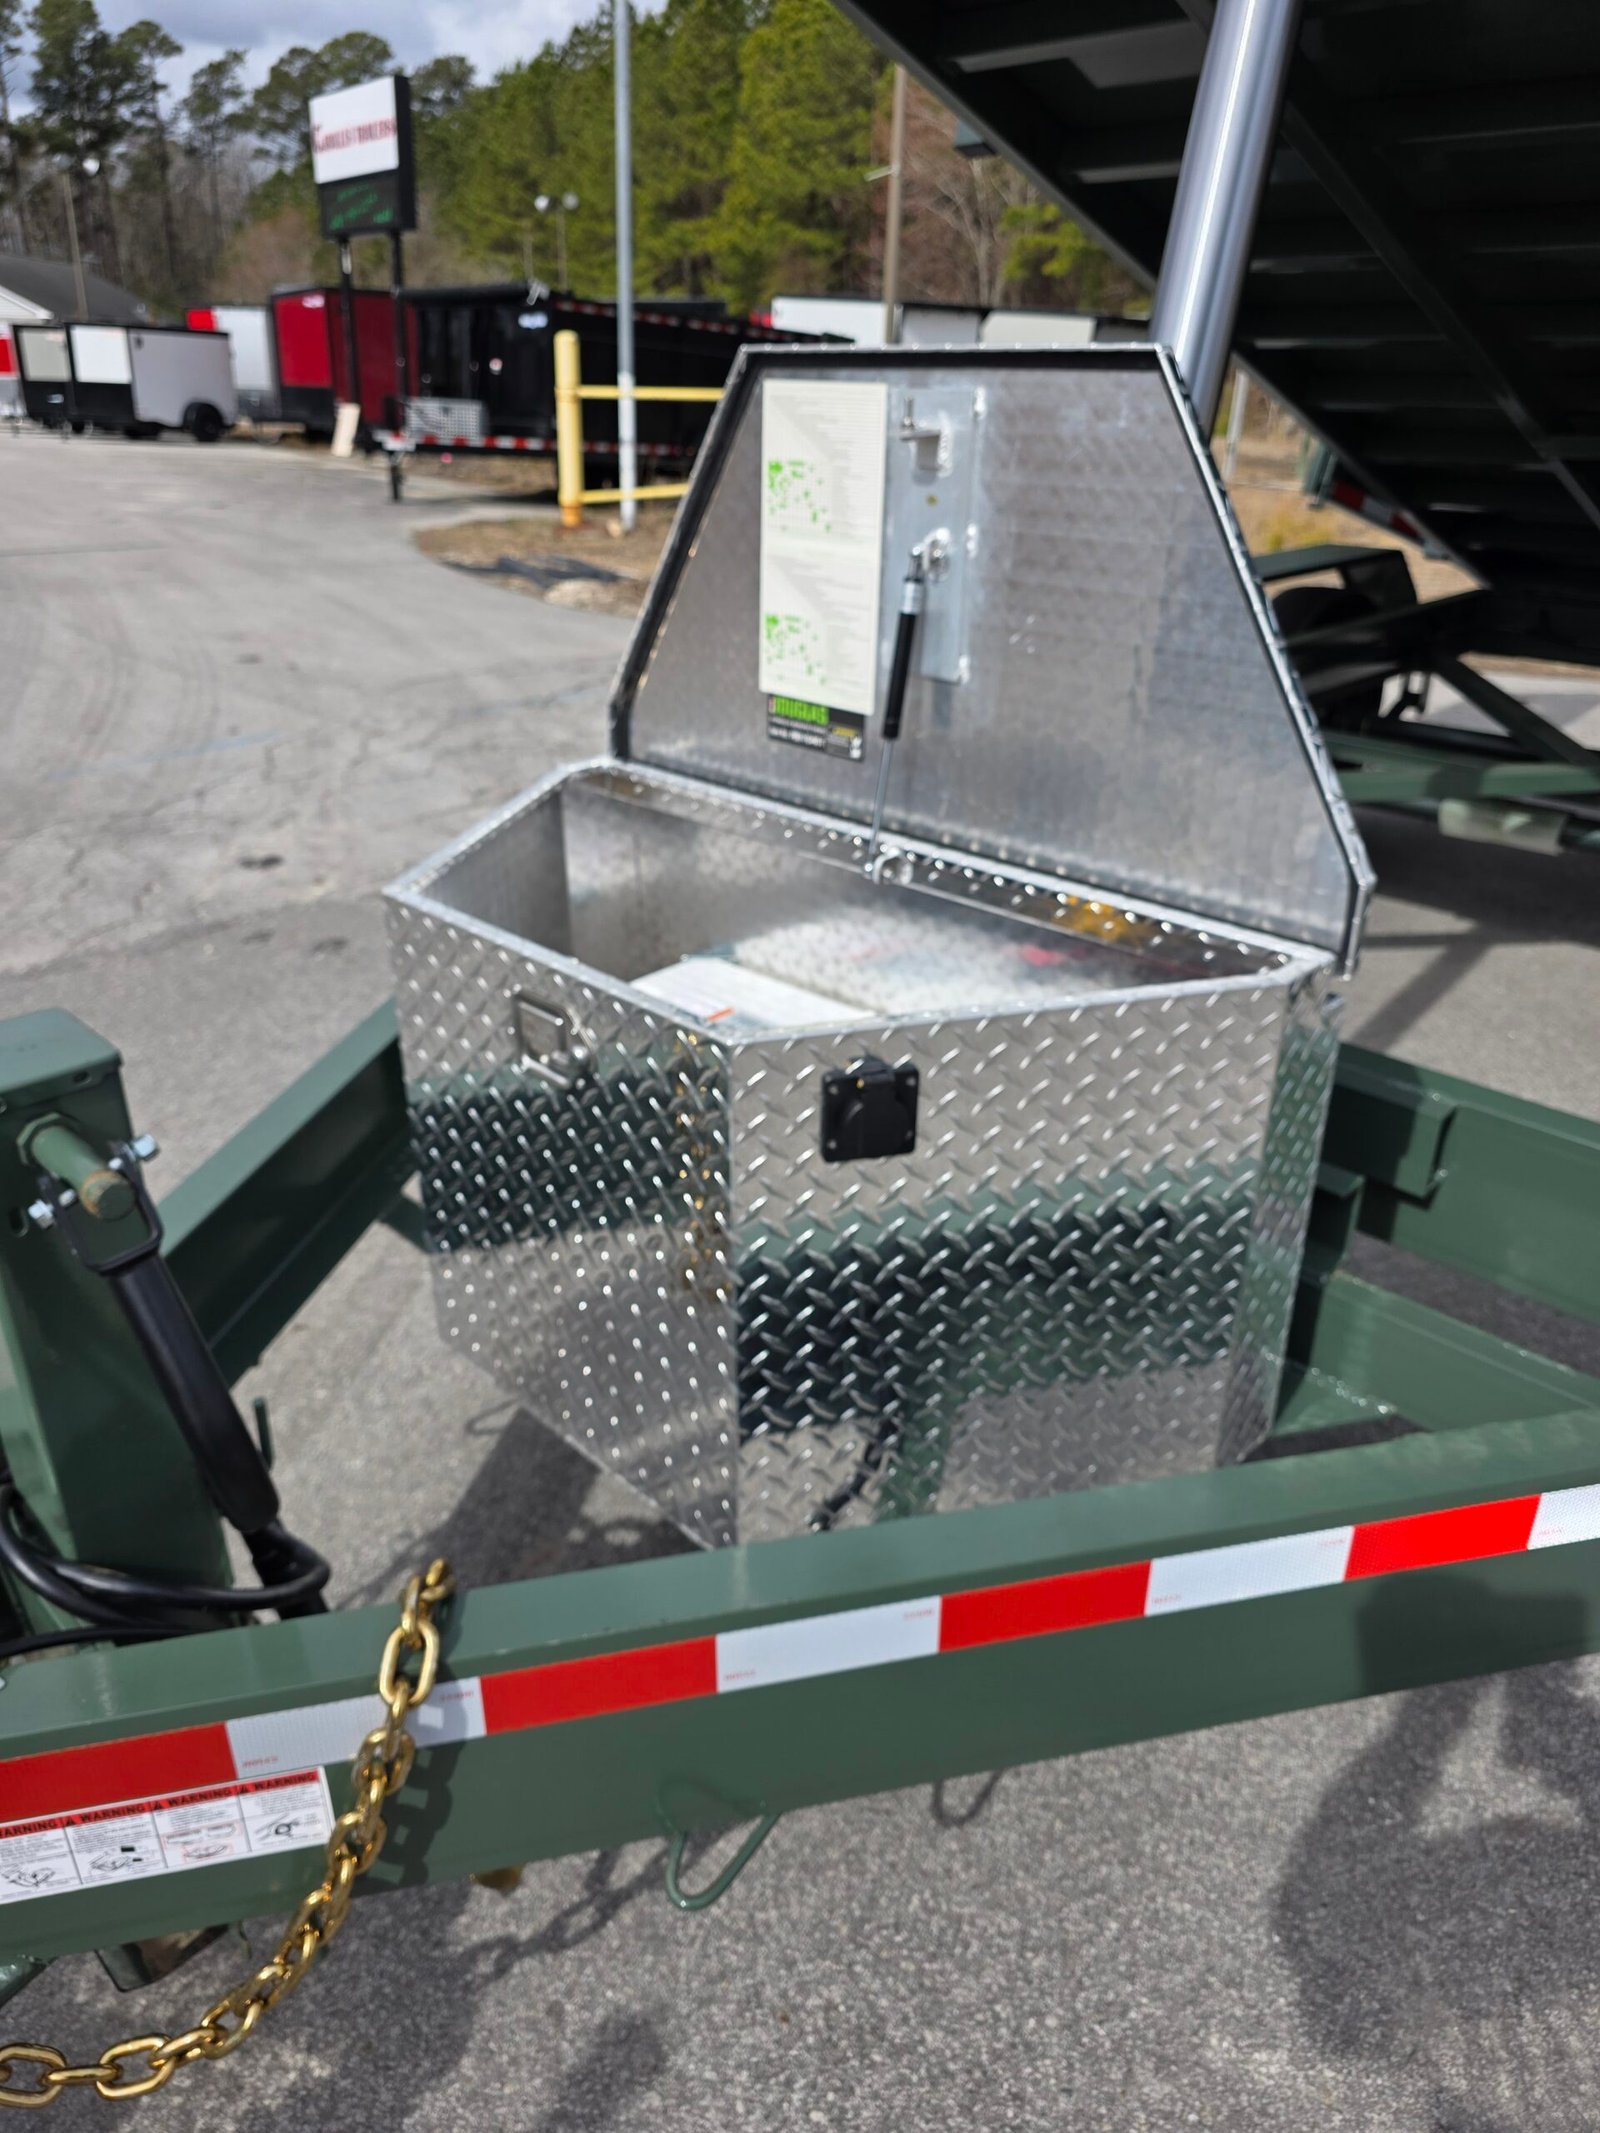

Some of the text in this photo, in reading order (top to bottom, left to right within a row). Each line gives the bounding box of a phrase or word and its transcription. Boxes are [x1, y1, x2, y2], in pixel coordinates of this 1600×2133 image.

[254, 1772, 315, 1791] WARNING
[168, 1789, 233, 1807] WARNING
[80, 1806, 146, 1824] WARNING
